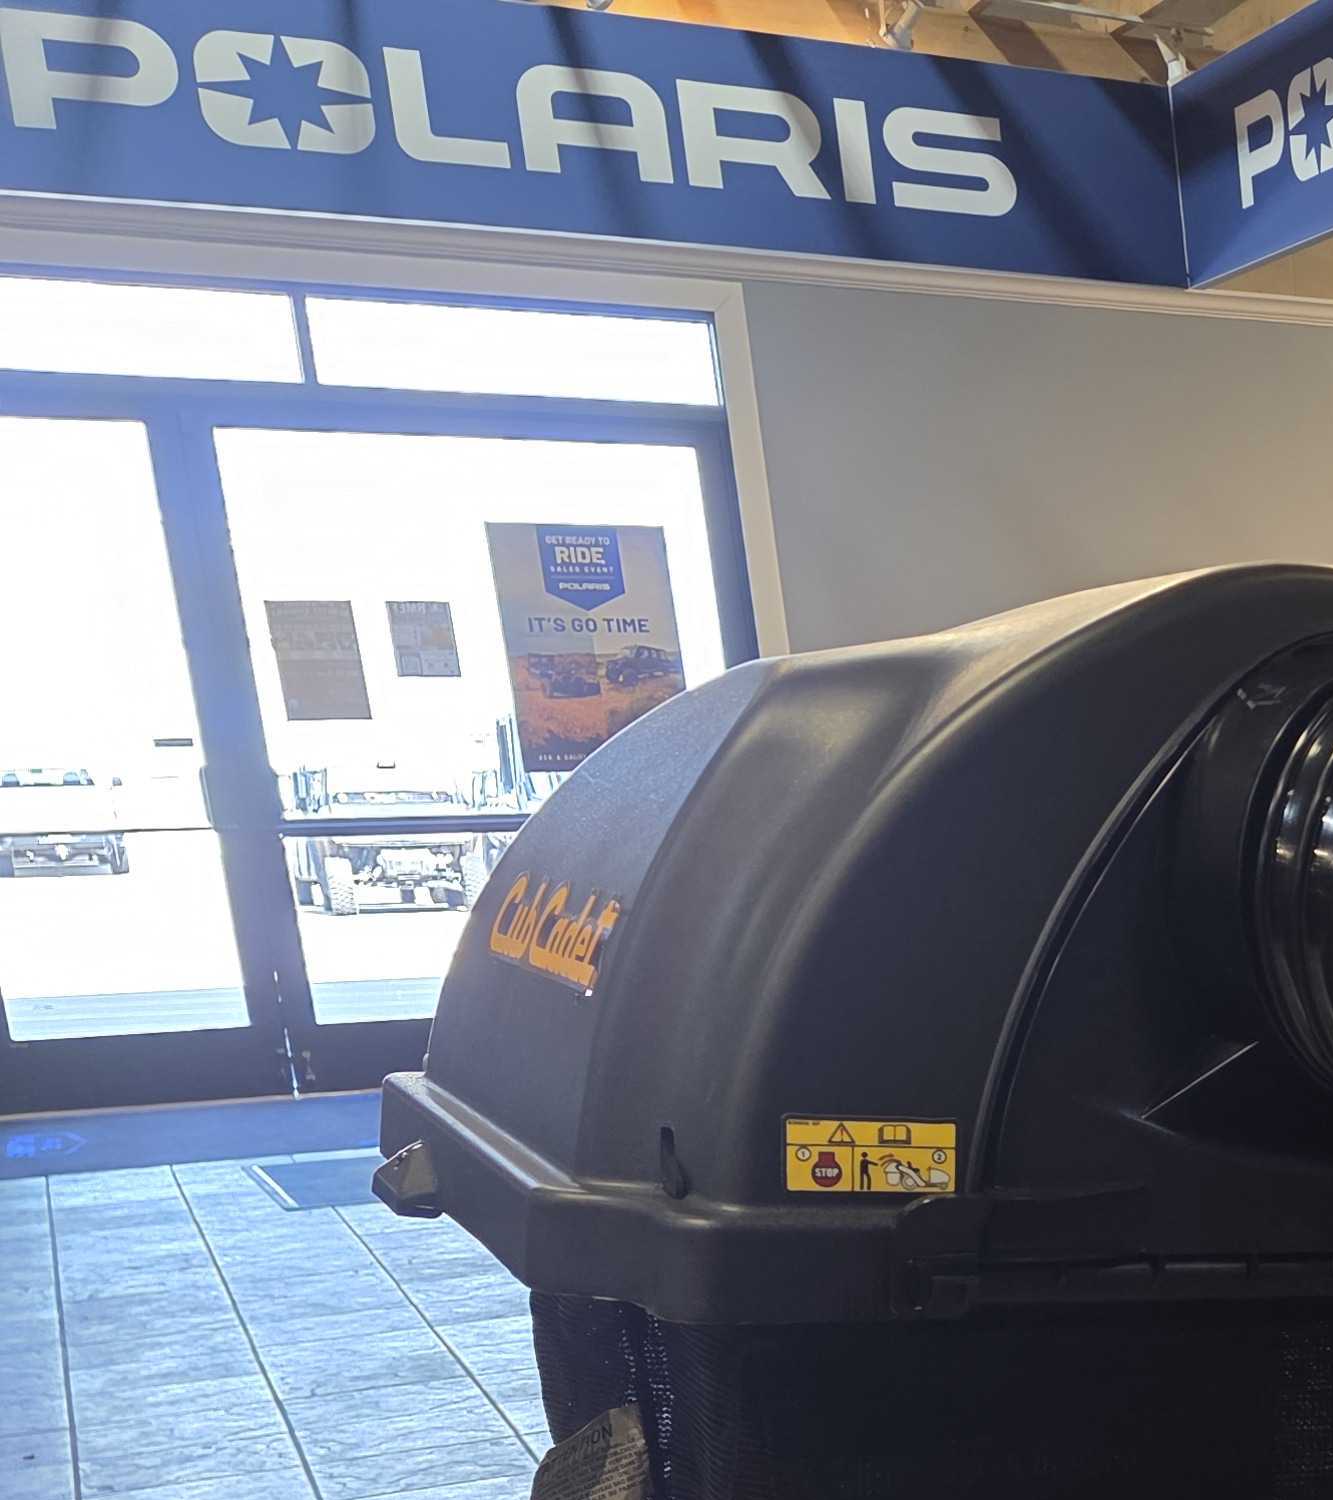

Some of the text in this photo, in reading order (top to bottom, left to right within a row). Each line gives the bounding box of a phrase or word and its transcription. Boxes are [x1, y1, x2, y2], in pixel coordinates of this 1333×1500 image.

[0, 9, 1017, 217] POLARIS
[555, 546, 606, 564] RIDE
[559, 582, 611, 590] POLARIS
[527, 617, 650, 634] IT'S GO TIME
[490, 873, 620, 991] Cub Cadet
[815, 1167, 840, 1178] STOP
